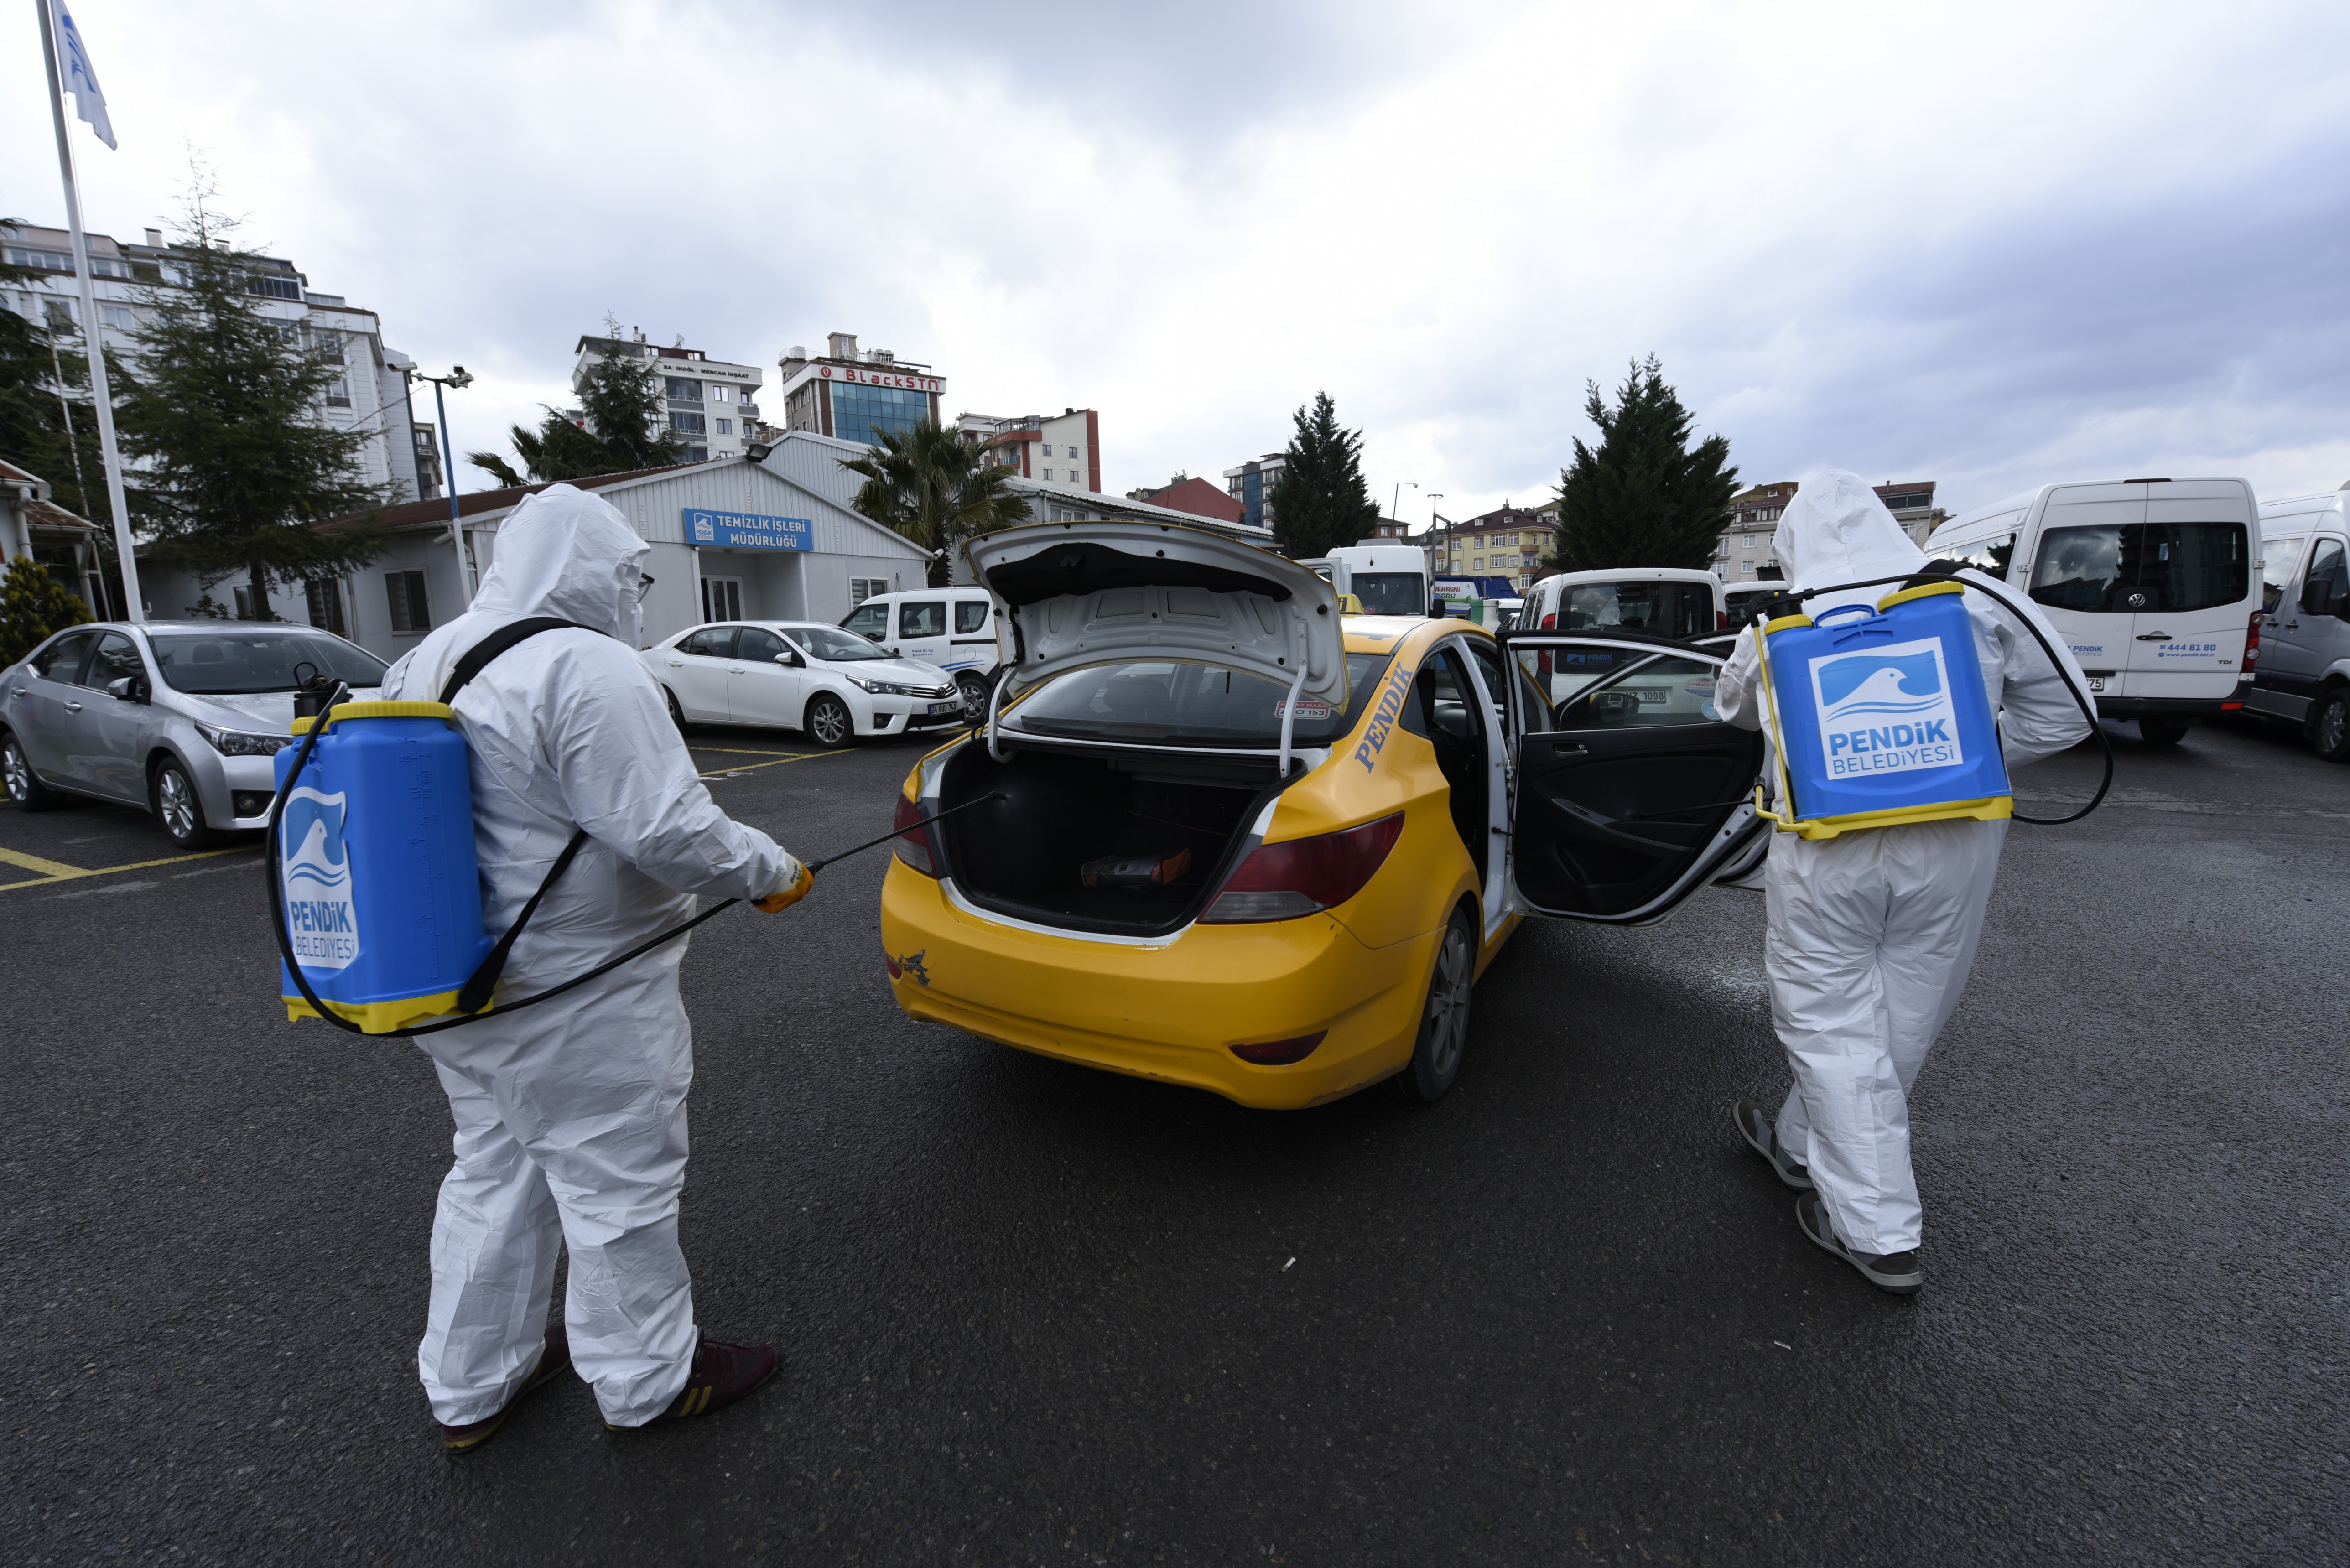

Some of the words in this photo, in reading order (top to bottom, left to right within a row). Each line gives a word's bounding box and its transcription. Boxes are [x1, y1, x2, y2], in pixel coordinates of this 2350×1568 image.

[717, 515, 770, 530] TEMİZLİK
[772, 518, 805, 533] İŞLERİ
[731, 531, 797, 548] MÜDÜRLÜĞÜ
[2086, 679, 2101, 688] 75
[1643, 692, 1664, 700] 1098
